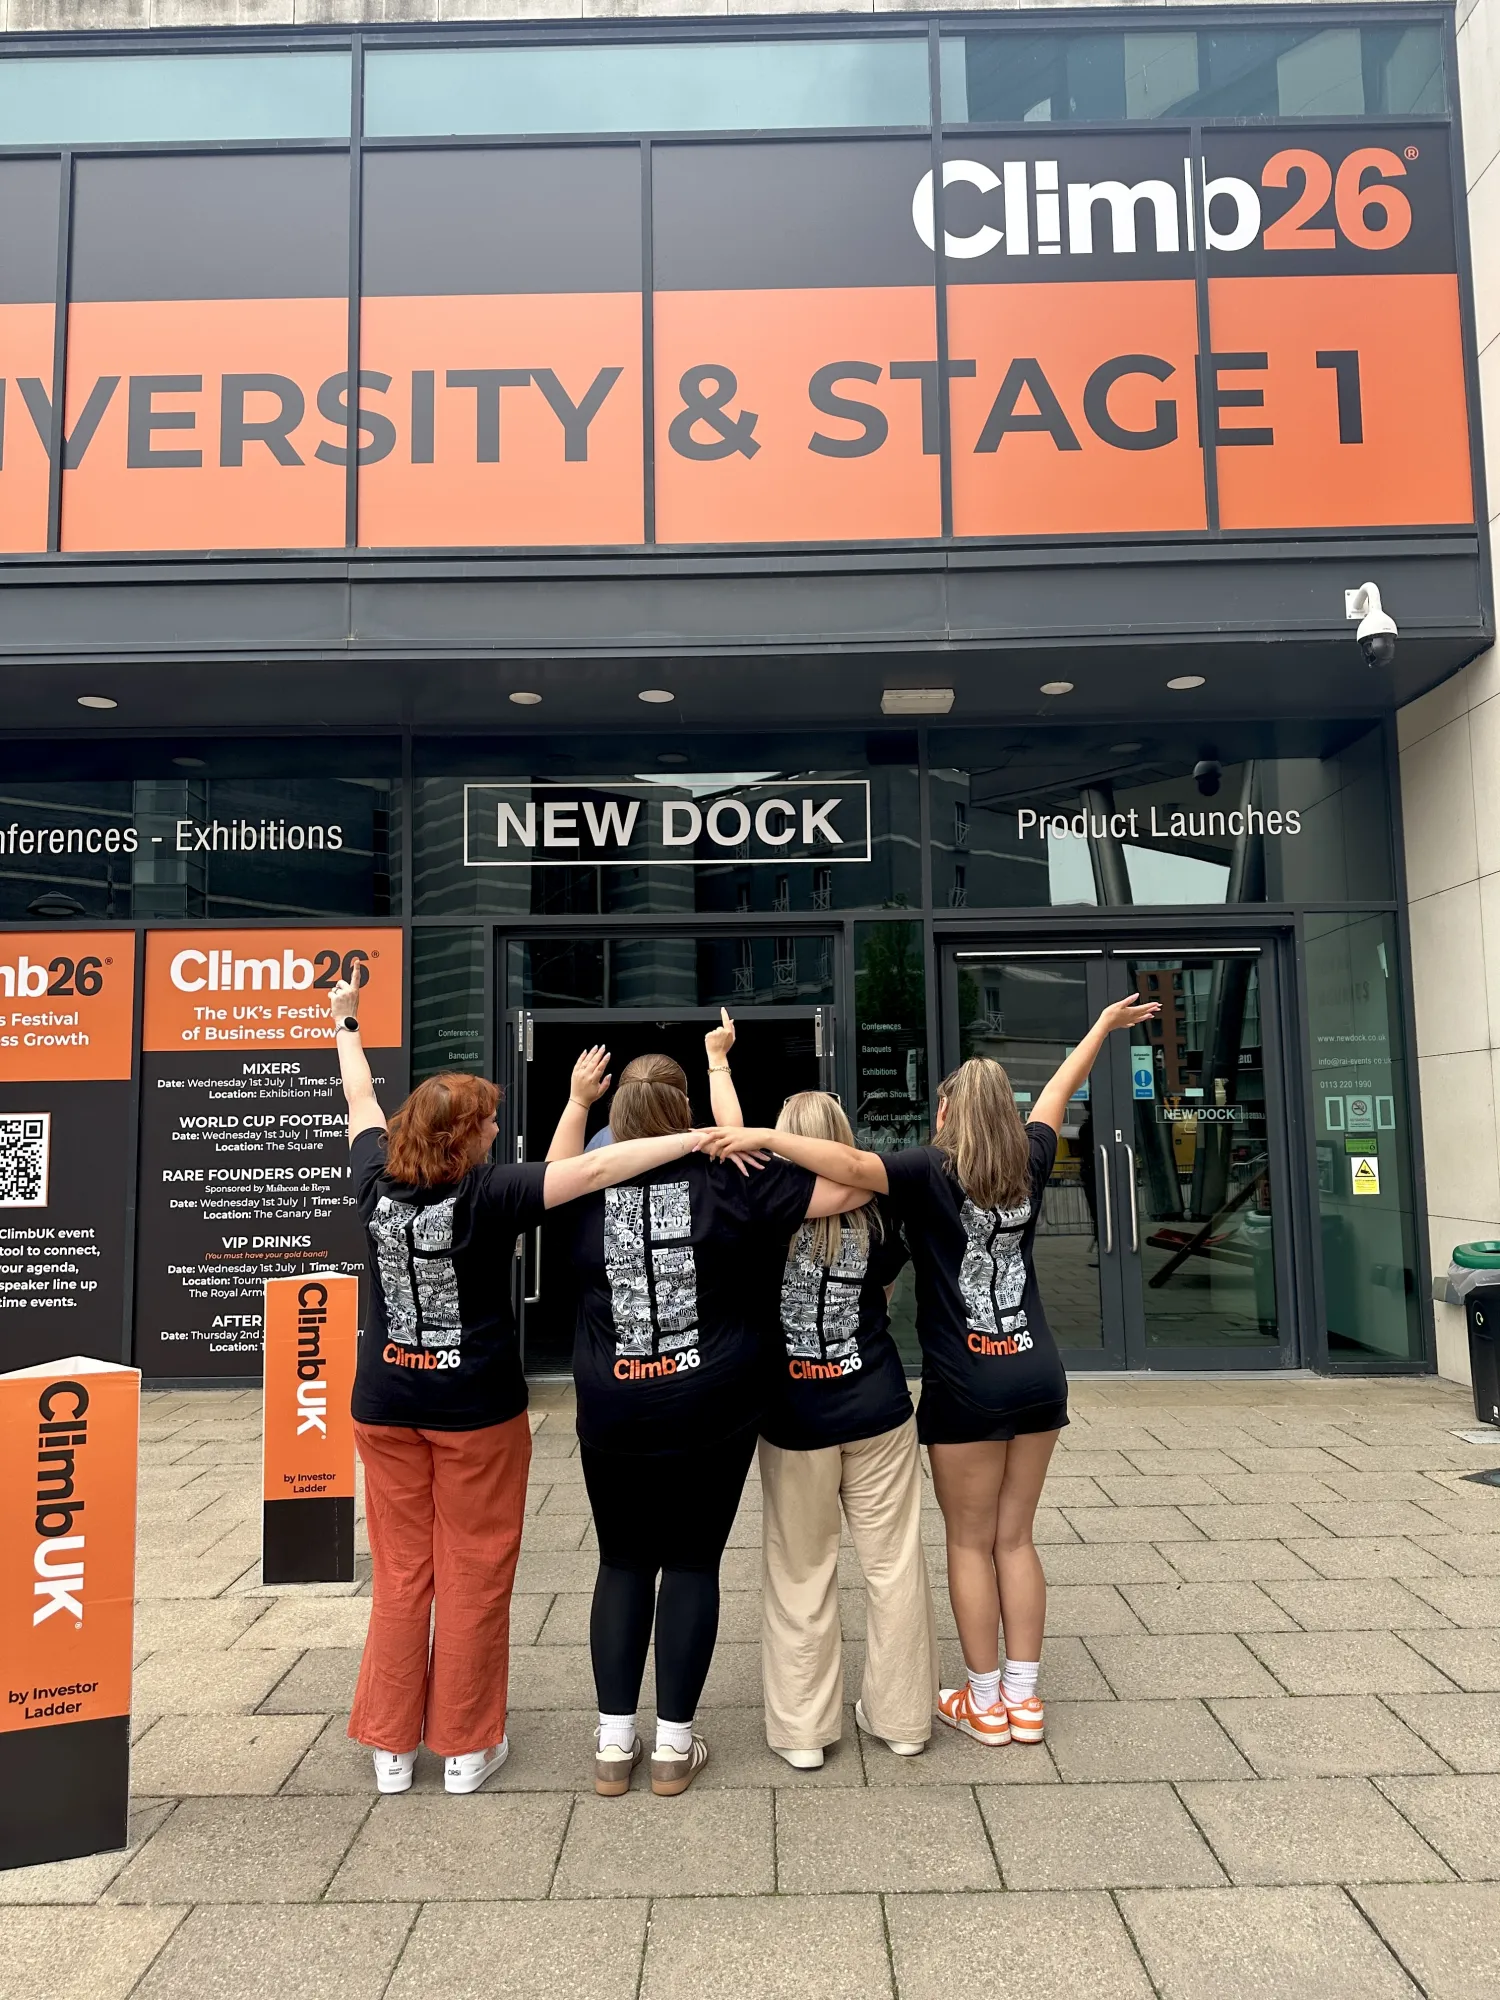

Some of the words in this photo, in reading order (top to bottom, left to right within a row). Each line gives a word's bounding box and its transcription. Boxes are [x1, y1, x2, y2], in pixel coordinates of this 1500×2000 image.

[0, 366, 624, 471] VERSITY
[668, 363, 762, 461] &
[807, 351, 1274, 458] STAGE
[1315, 349, 1363, 444] 1
[497, 801, 640, 847] NEW
[662, 798, 843, 846] DOCK
[1017, 807, 1139, 841] Product
[1152, 804, 1301, 838] Launches
[176, 820, 343, 851] Exhibitions
[194, 1007, 226, 1020] The
[232, 1005, 272, 1019] UK's
[278, 1005, 334, 1018] Festiv
[11, 1011, 78, 1027] Festival
[24, 1032, 89, 1046] Growth
[181, 1026, 199, 1041] of
[205, 1027, 284, 1040] Business
[290, 1026, 337, 1038] Grow
[1318, 1034, 1386, 1042] www.newdock.co.uk
[449, 1052, 478, 1060] Banquets
[862, 1046, 892, 1054] Banquets
[243, 1063, 300, 1074] MIXERS
[158, 1080, 184, 1088] Date:
[188, 1078, 246, 1088] Wednesday
[249, 1078, 261, 1086] 1st
[264, 1078, 285, 1088] July
[298, 1077, 327, 1085] Time:
[330, 1077, 342, 1087] 5p
[1355, 1080, 1371, 1088] 1990
[209, 1090, 256, 1099] Location:
[260, 1089, 310, 1098] Exhibition
[314, 1088, 332, 1097] Hall
[1164, 1109, 1193, 1119] NEW
[1197, 1109, 1236, 1120] DOCK
[180, 1116, 238, 1128] WORLD
[243, 1116, 275, 1127] CUP
[280, 1114, 350, 1126] FOOTBAL
[173, 1131, 199, 1140] Date:
[202, 1131, 261, 1140] Wednesday
[264, 1130, 277, 1139] 1st
[279, 1130, 299, 1140] July
[313, 1129, 342, 1138] Time:
[216, 1142, 263, 1151] Location:
[266, 1142, 284, 1151] The
[287, 1141, 323, 1151] Square
[163, 1170, 203, 1181] RARE
[209, 1168, 294, 1181] FOUNDERS
[298, 1167, 341, 1179] OPEN
[205, 1185, 251, 1194] Sponsored
[254, 1184, 264, 1193] by
[300, 1184, 310, 1192] de
[312, 1183, 330, 1193] Reya
[170, 1199, 197, 1208] Date:
[200, 1198, 259, 1208] Wednesday
[262, 1198, 275, 1207] 1st
[278, 1198, 298, 1207] July
[312, 1196, 340, 1205] Time:
[343, 1196, 357, 1207] 5p
[204, 1210, 251, 1219] Location:
[254, 1210, 272, 1218] The
[275, 1209, 311, 1220] Canary
[315, 1209, 331, 1218] Bar
[0, 1228, 55, 1239] ClimbUK
[58, 1228, 95, 1238] event
[222, 1237, 248, 1248] VIP
[253, 1236, 311, 1248] DRINKS
[0, 1244, 23, 1256] tool
[27, 1245, 40, 1256] to
[44, 1245, 100, 1257] connect,
[205, 1252, 222, 1260] (You
[245, 1251, 262, 1259] have
[264, 1252, 282, 1260] your
[284, 1251, 301, 1260] gold
[303, 1250, 327, 1259] band!)
[0, 1264, 23, 1273] our
[27, 1262, 79, 1275] agenda,
[168, 1265, 195, 1274] Date:
[198, 1264, 257, 1274] Wednesday
[260, 1264, 273, 1273] 1st
[275, 1264, 296, 1273] July
[310, 1262, 338, 1271] Time:
[341, 1262, 364, 1272] 7pm
[0, 1279, 49, 1292] speaker
[53, 1279, 76, 1290] line
[81, 1280, 97, 1292] up
[183, 1276, 230, 1286] Location:
[233, 1277, 283, 1285] Tourna
[189, 1289, 208, 1298] The
[211, 1288, 238, 1298] Royal
[31, 1296, 77, 1307] events.
[212, 1315, 262, 1327] AFTER
[161, 1332, 188, 1340] Date:
[191, 1331, 238, 1341] Thursday
[240, 1330, 259, 1339] 2nd
[210, 1342, 257, 1352] Location:
[967, 1331, 1033, 1357] Climb26
[383, 1343, 461, 1370] Climb26
[613, 1348, 700, 1381] Climb26
[789, 1352, 862, 1380] Climb26
[284, 1474, 295, 1483] by
[298, 1473, 336, 1481] Investor
[294, 1484, 326, 1493] Ladder
[9, 1689, 29, 1704] by
[33, 1680, 98, 1700] Investor
[25, 1700, 82, 1720] Ladder
